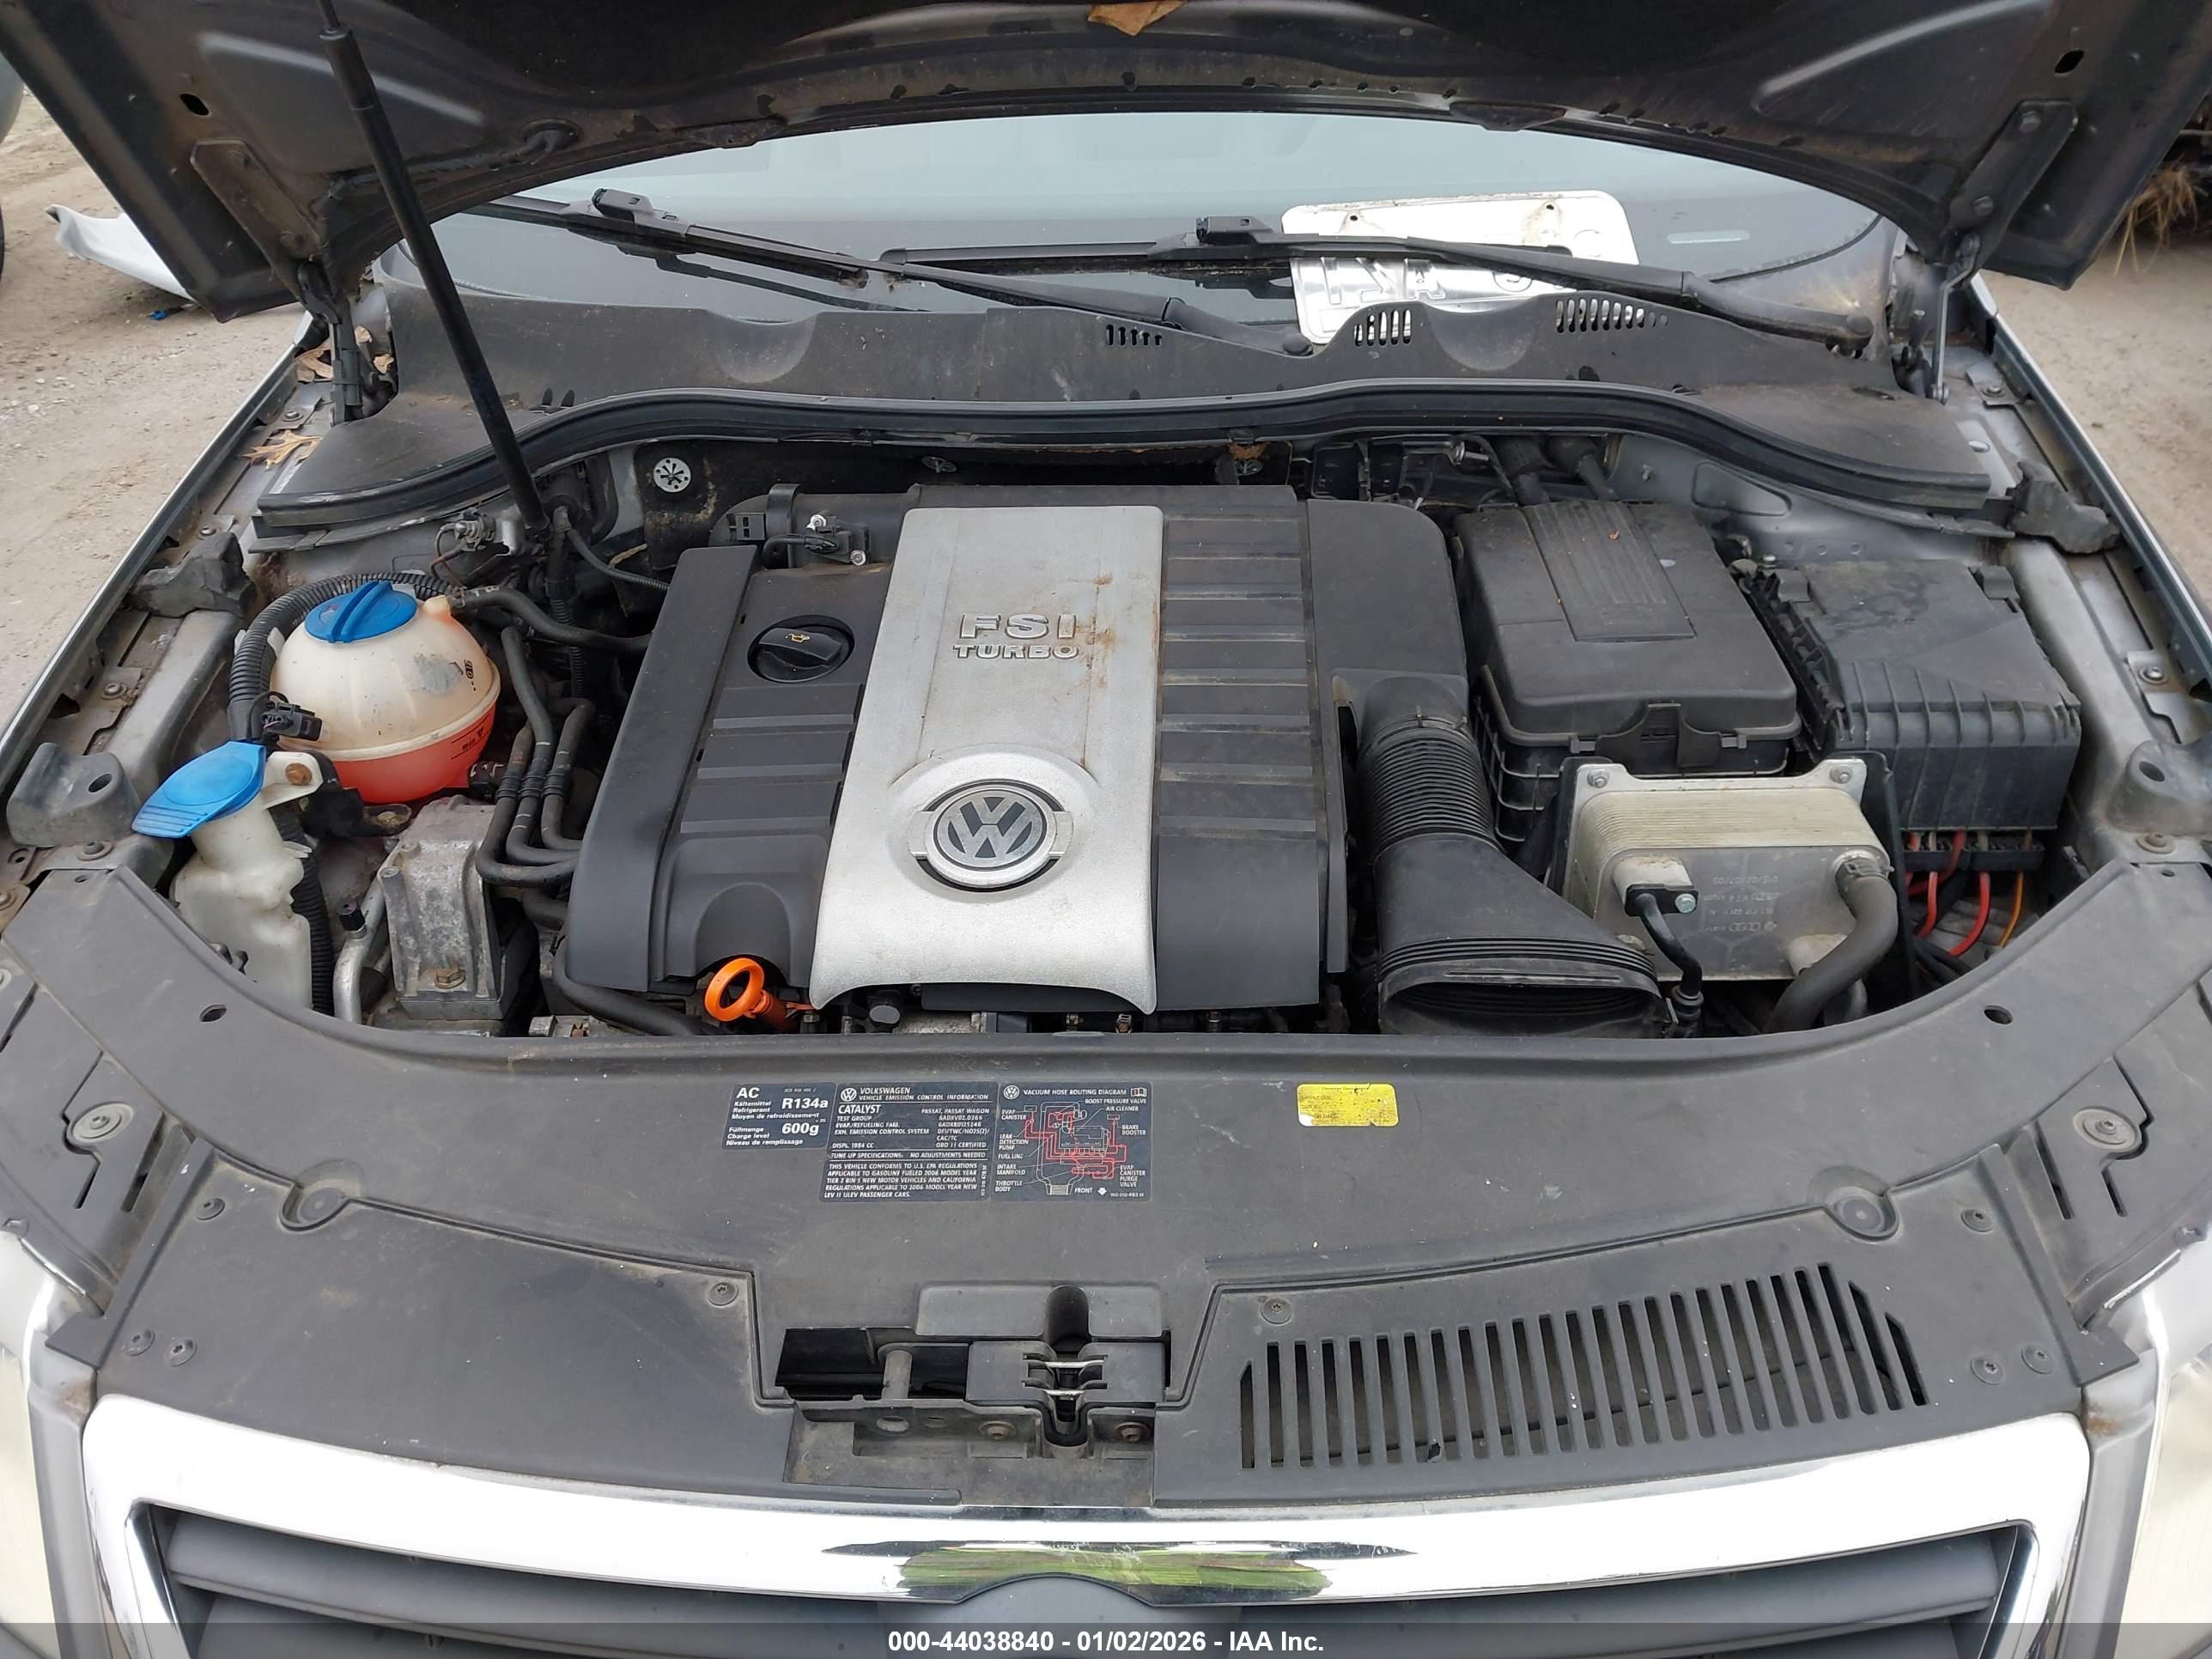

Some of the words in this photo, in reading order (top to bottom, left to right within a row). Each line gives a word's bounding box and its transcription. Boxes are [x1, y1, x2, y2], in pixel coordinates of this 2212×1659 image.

[959, 612, 1078, 640] FSI
[952, 644, 1079, 659] TURBO
[736, 1087, 760, 1098] AC
[781, 1098, 829, 1109] R134a
[838, 1104, 881, 1114] CATALYST
[782, 1123, 819, 1136] 600g
